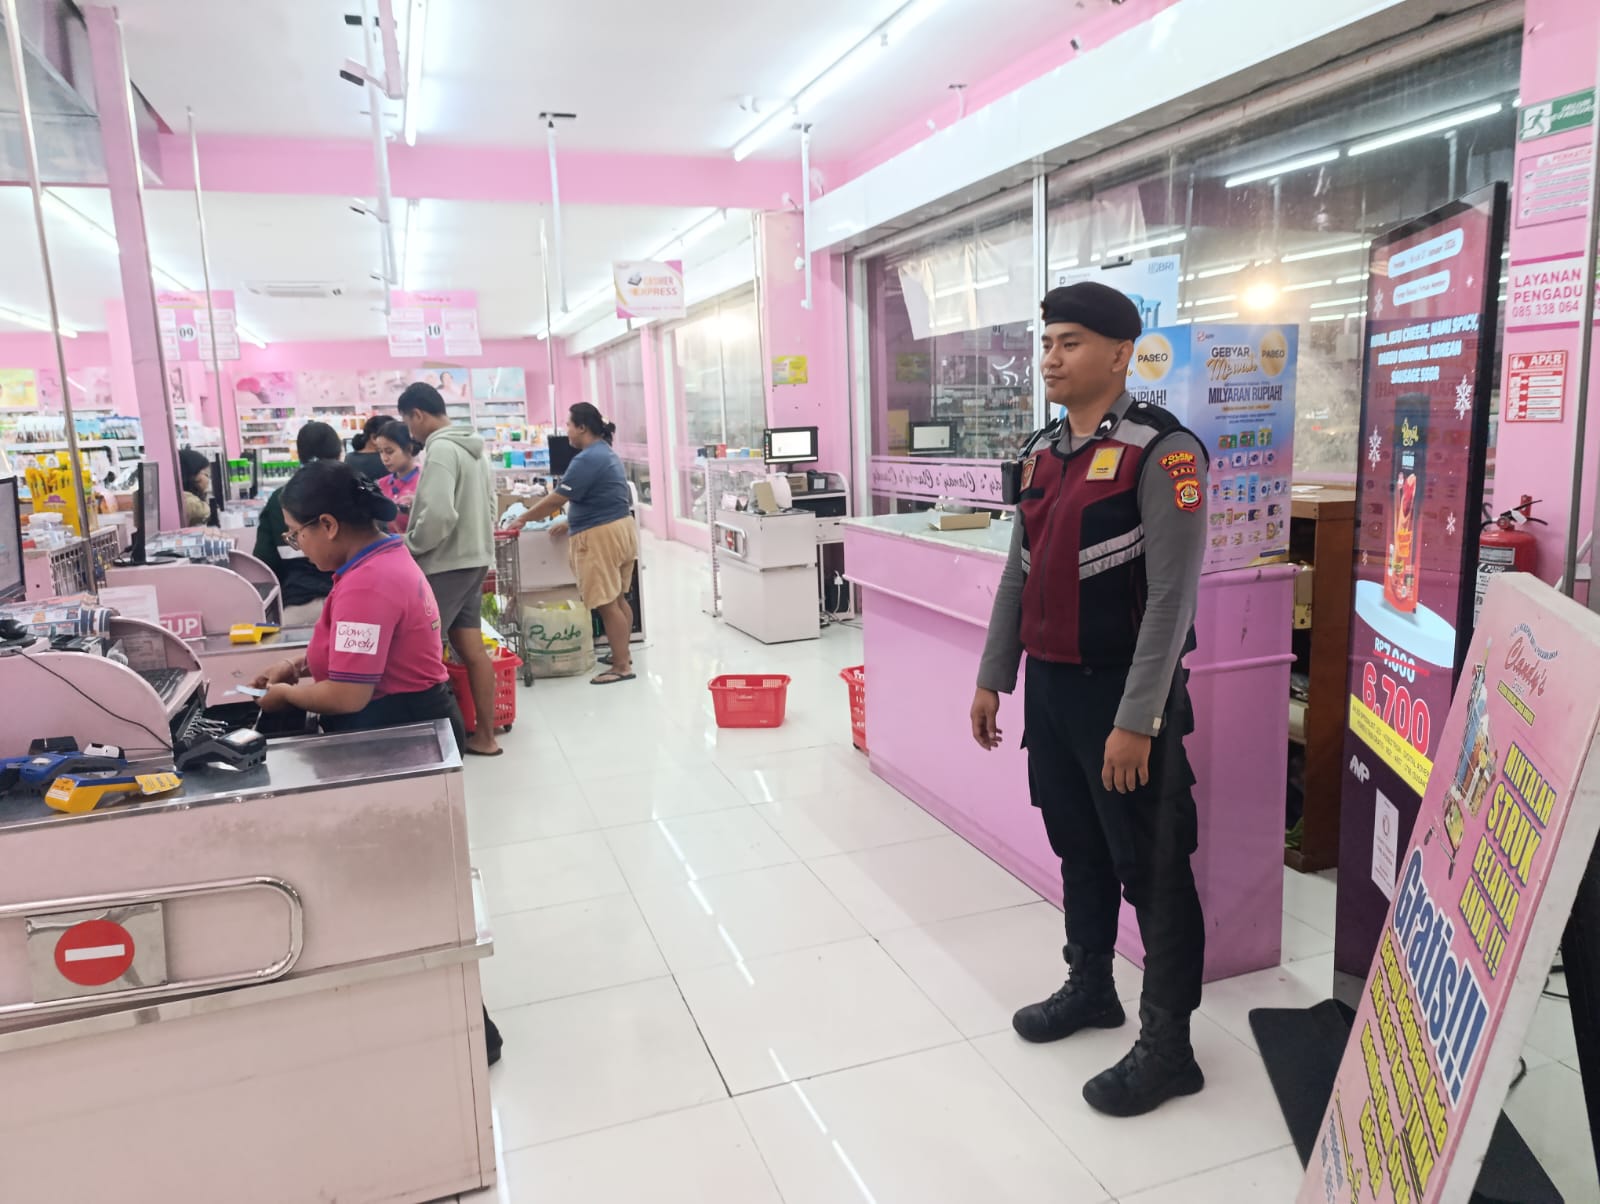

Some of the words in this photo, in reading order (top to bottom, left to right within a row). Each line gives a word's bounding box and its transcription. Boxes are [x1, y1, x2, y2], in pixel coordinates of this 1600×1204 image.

[1514, 268, 1582, 288] LAYANAN
[1513, 285, 1583, 303] PENGADU
[1511, 305, 1532, 318] 085
[1536, 302, 1555, 315] 338
[1559, 300, 1579, 312] 064
[180, 328, 194, 337] 09
[428, 325, 440, 336] 10
[1137, 353, 1169, 363] PASEO
[1211, 346, 1250, 358] GEBYAR
[1261, 349, 1286, 359] PASEO
[1529, 353, 1562, 366] APAR
[1208, 386, 1251, 405] MILYARAN
[1251, 384, 1283, 402] RUPIAH!
[1172, 468, 1194, 477] BALI
[344, 637, 375, 651] Lovely
[529, 624, 581, 650] Pepito
[1362, 662, 1431, 756] 6.700
[1503, 742, 1557, 829] MINTALAH
[1487, 781, 1542, 888] STRUK
[1473, 833, 1520, 935] BELANJA
[1458, 874, 1493, 954] ANDA
[1394, 847, 1490, 1108] Gratis!!!
[1380, 926, 1403, 1004] Barang
[1396, 978, 1430, 1098] Belanjaan
[1423, 1072, 1448, 1157] Anda
[1360, 1019, 1394, 1156] memberikan
[1370, 966, 1386, 1020] Jika
[1379, 998, 1399, 1065] kasir
[1391, 1045, 1414, 1120] kami
[1404, 1093, 1435, 1198] TIDAK
